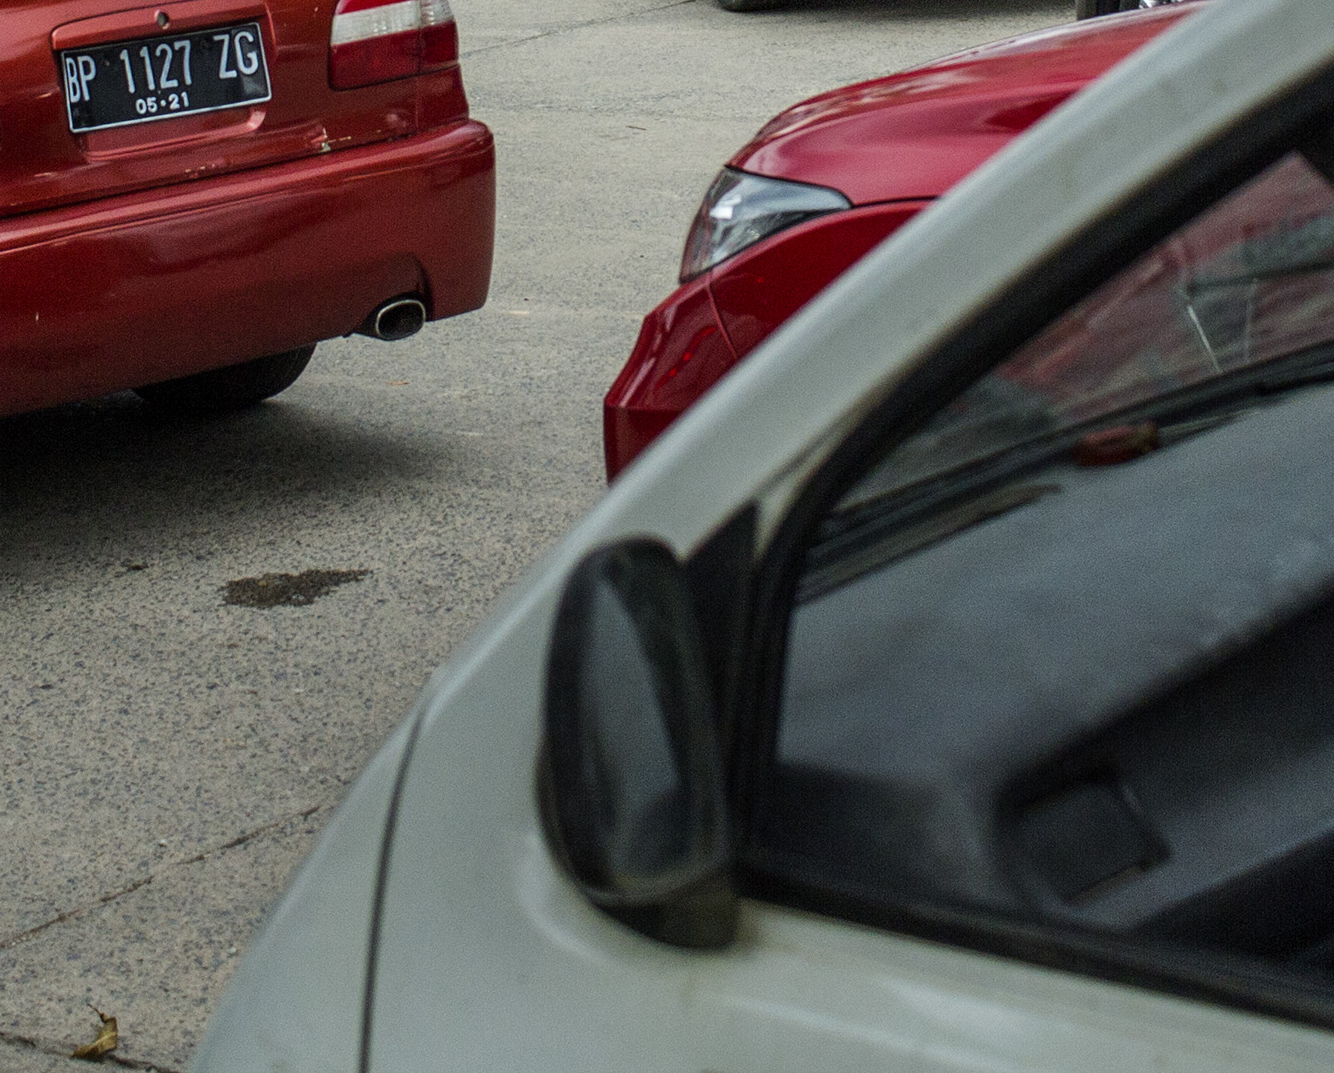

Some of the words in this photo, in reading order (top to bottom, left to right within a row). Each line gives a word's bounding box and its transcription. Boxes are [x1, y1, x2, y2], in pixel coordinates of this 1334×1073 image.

[66, 54, 97, 103] BP
[120, 39, 193, 94] 1127
[213, 31, 260, 79] ZG
